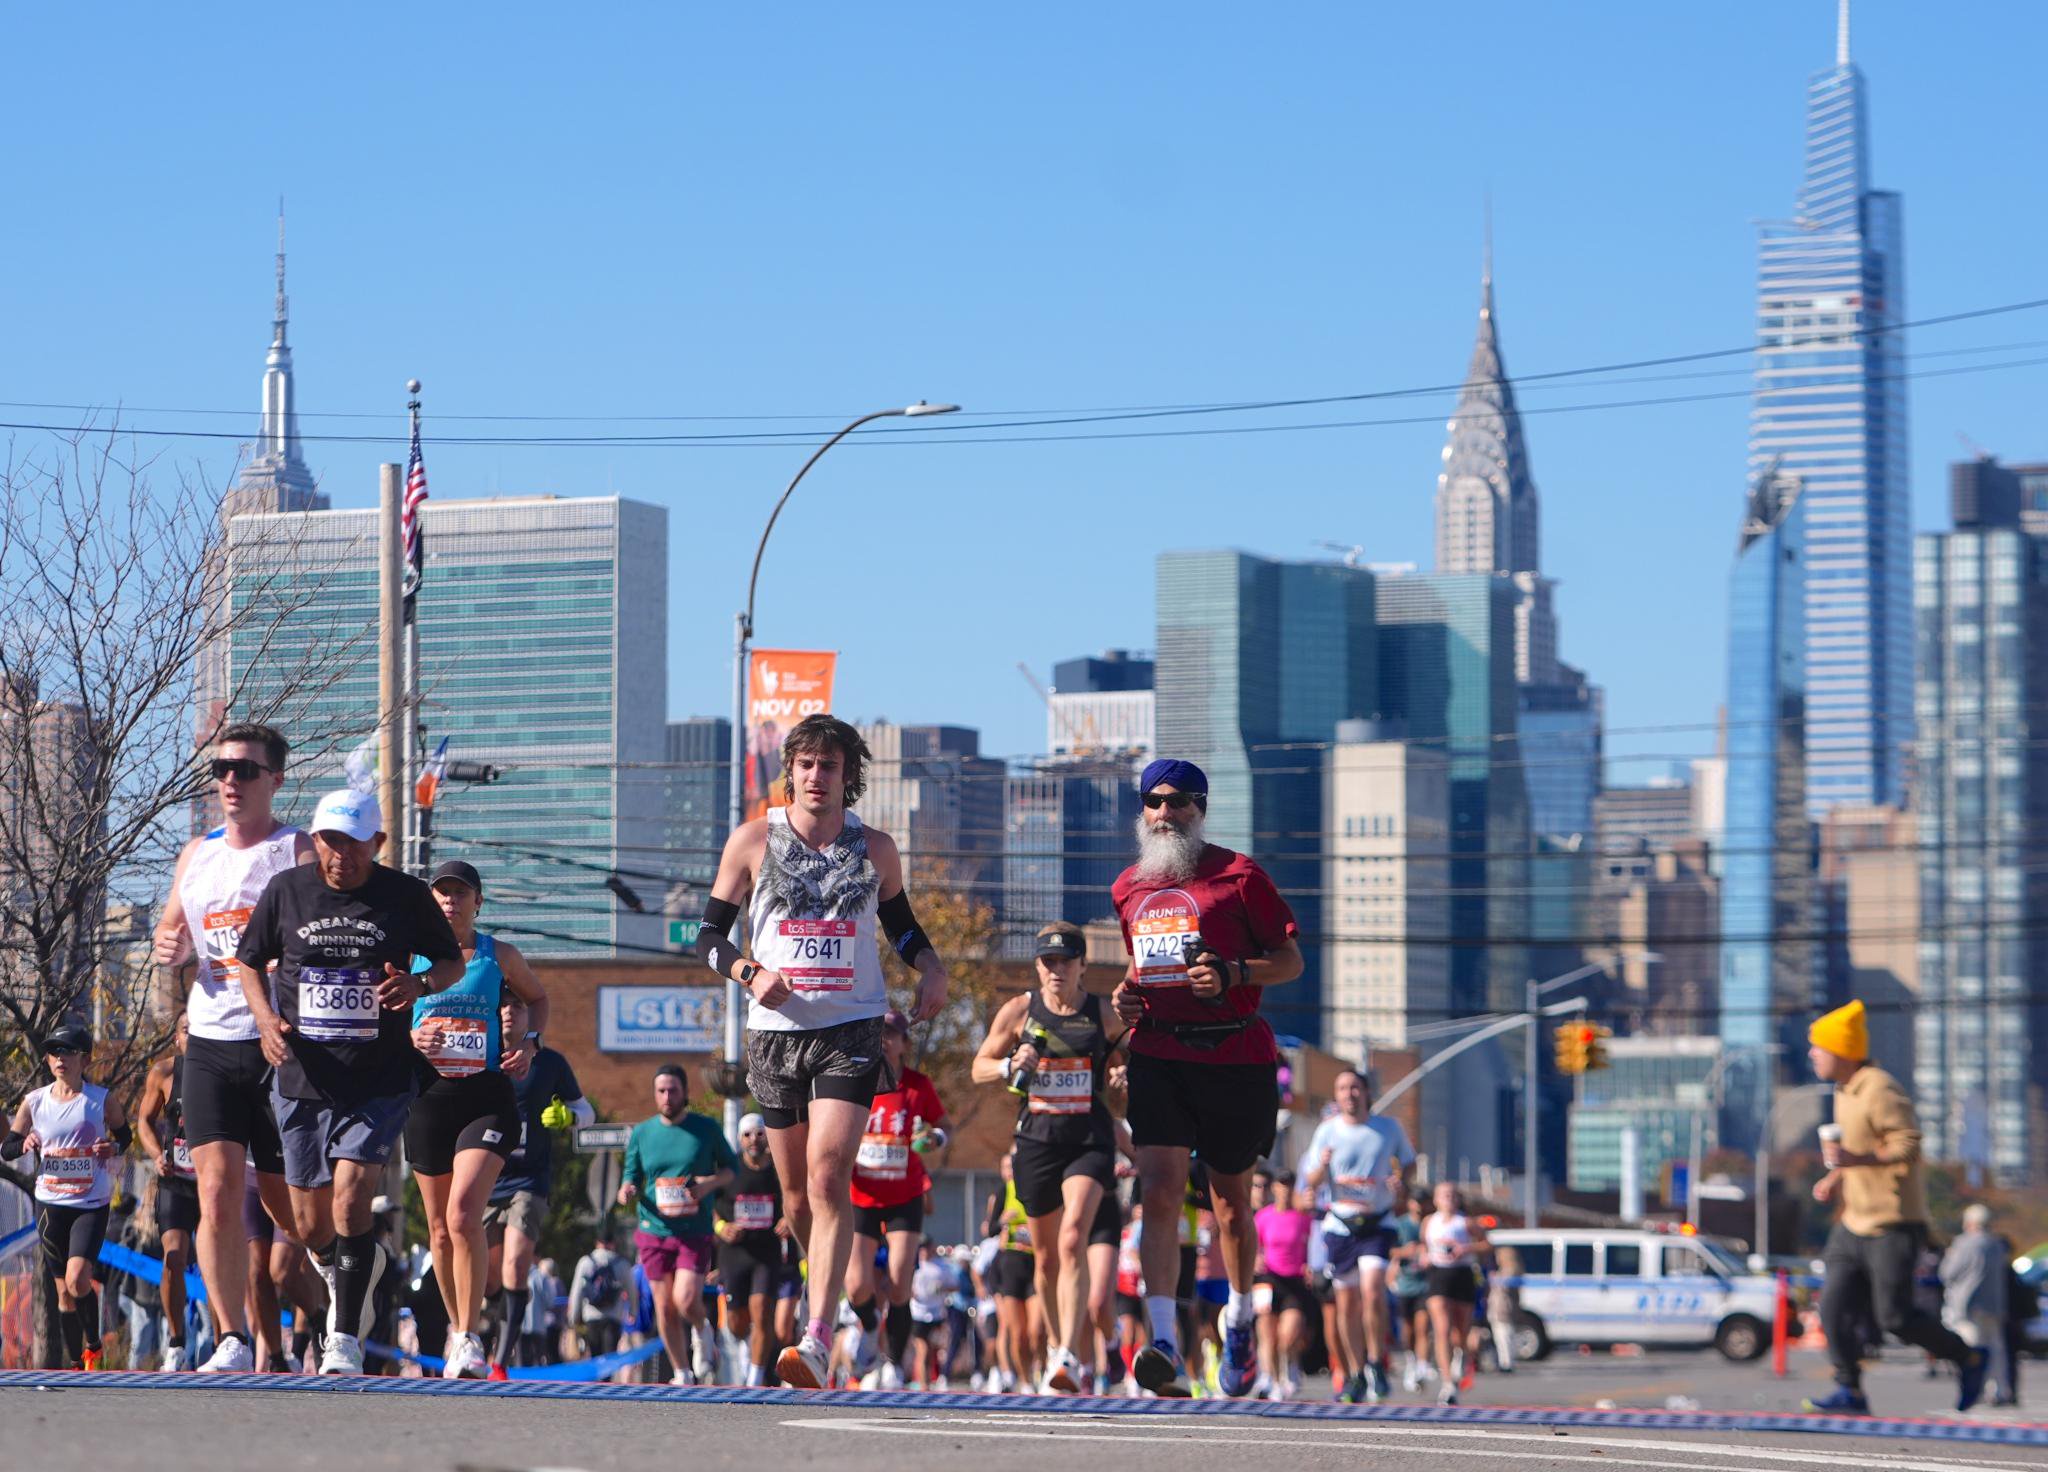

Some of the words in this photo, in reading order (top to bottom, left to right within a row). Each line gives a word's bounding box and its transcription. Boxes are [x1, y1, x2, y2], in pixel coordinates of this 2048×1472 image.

[753, 699, 796, 717] NOV
[799, 699, 825, 716] 02
[1148, 907, 1174, 919] RUN
[296, 916, 386, 941] DREAMERS
[788, 922, 805, 934] tcs
[308, 934, 376, 947] RUNNING
[323, 947, 360, 958] CLUB
[792, 937, 841, 960] 7641
[309, 970, 327, 983] tcs
[306, 985, 374, 1010] 13866
[425, 993, 477, 1005] ASHFORD
[480, 994, 487, 1004] &
[1033, 1072, 1051, 1088] AG
[1055, 1072, 1088, 1088] 3617
[45, 1160, 60, 1171] AG
[62, 1160, 90, 1171] 3538
